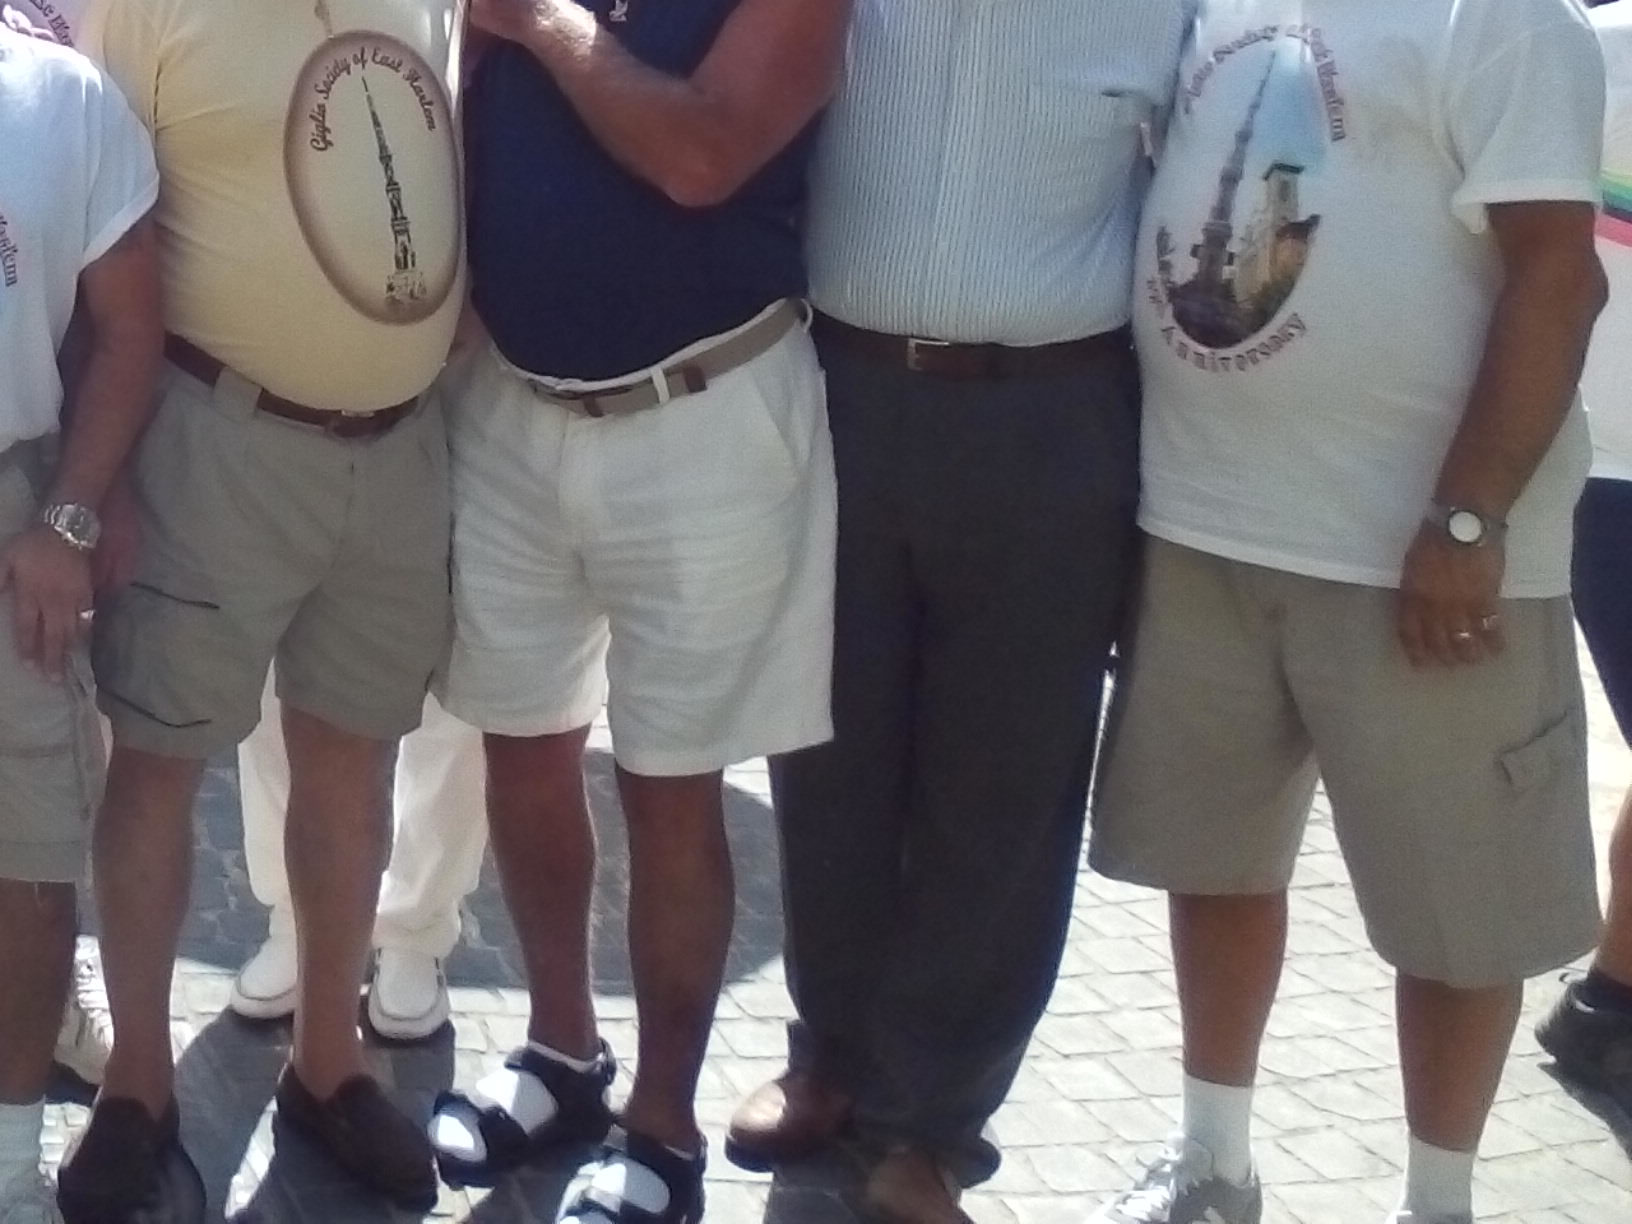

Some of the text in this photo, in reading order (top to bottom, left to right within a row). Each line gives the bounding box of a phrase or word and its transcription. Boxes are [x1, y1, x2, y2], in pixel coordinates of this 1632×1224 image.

[310, 46, 436, 152] Giglio Society of East Harlem
